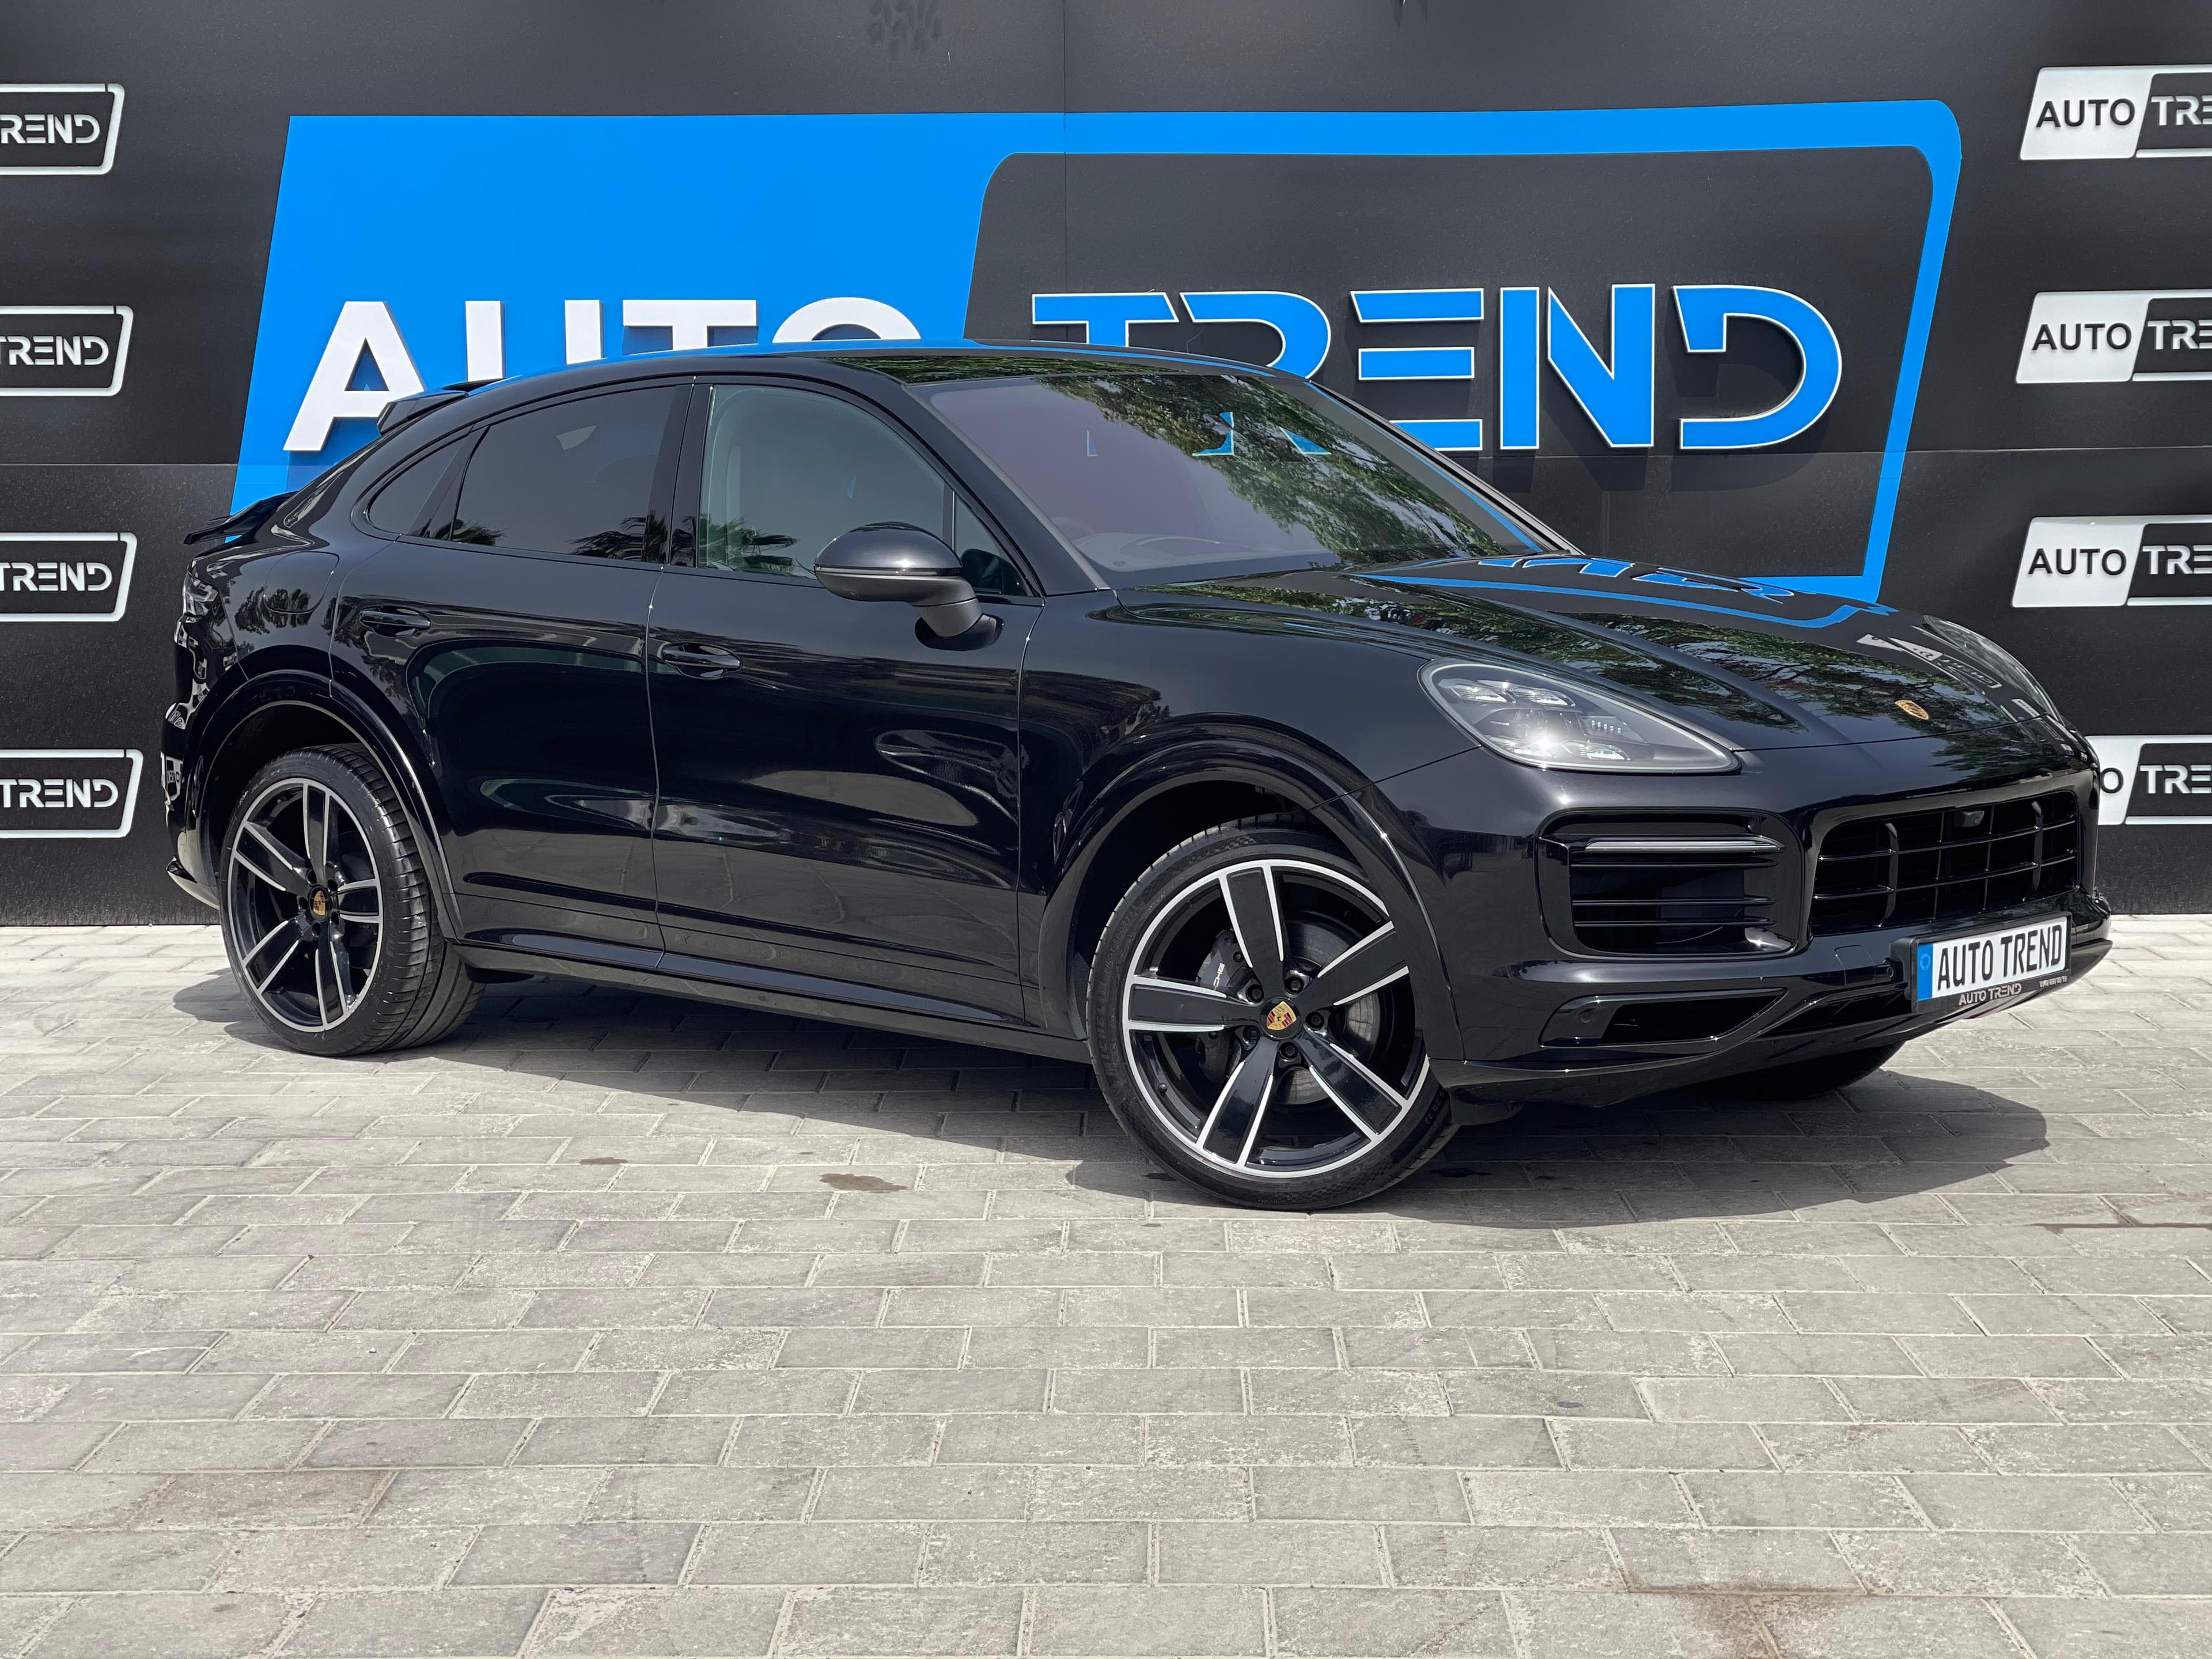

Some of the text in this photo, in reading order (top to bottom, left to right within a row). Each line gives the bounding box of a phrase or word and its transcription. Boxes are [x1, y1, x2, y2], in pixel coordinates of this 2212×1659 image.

[2035, 94, 2212, 128] AUTO TRE
[0, 113, 101, 144] REND
[0, 335, 109, 366] REND
[2031, 319, 2212, 351] AUTO TRE
[2027, 544, 2212, 576] AUTO TRE
[0, 778, 119, 808] TREND
[2139, 764, 2212, 794] TRE
[1937, 924, 2063, 991] AUTO TREND
[1958, 982, 2022, 1006] AUTO TREND
